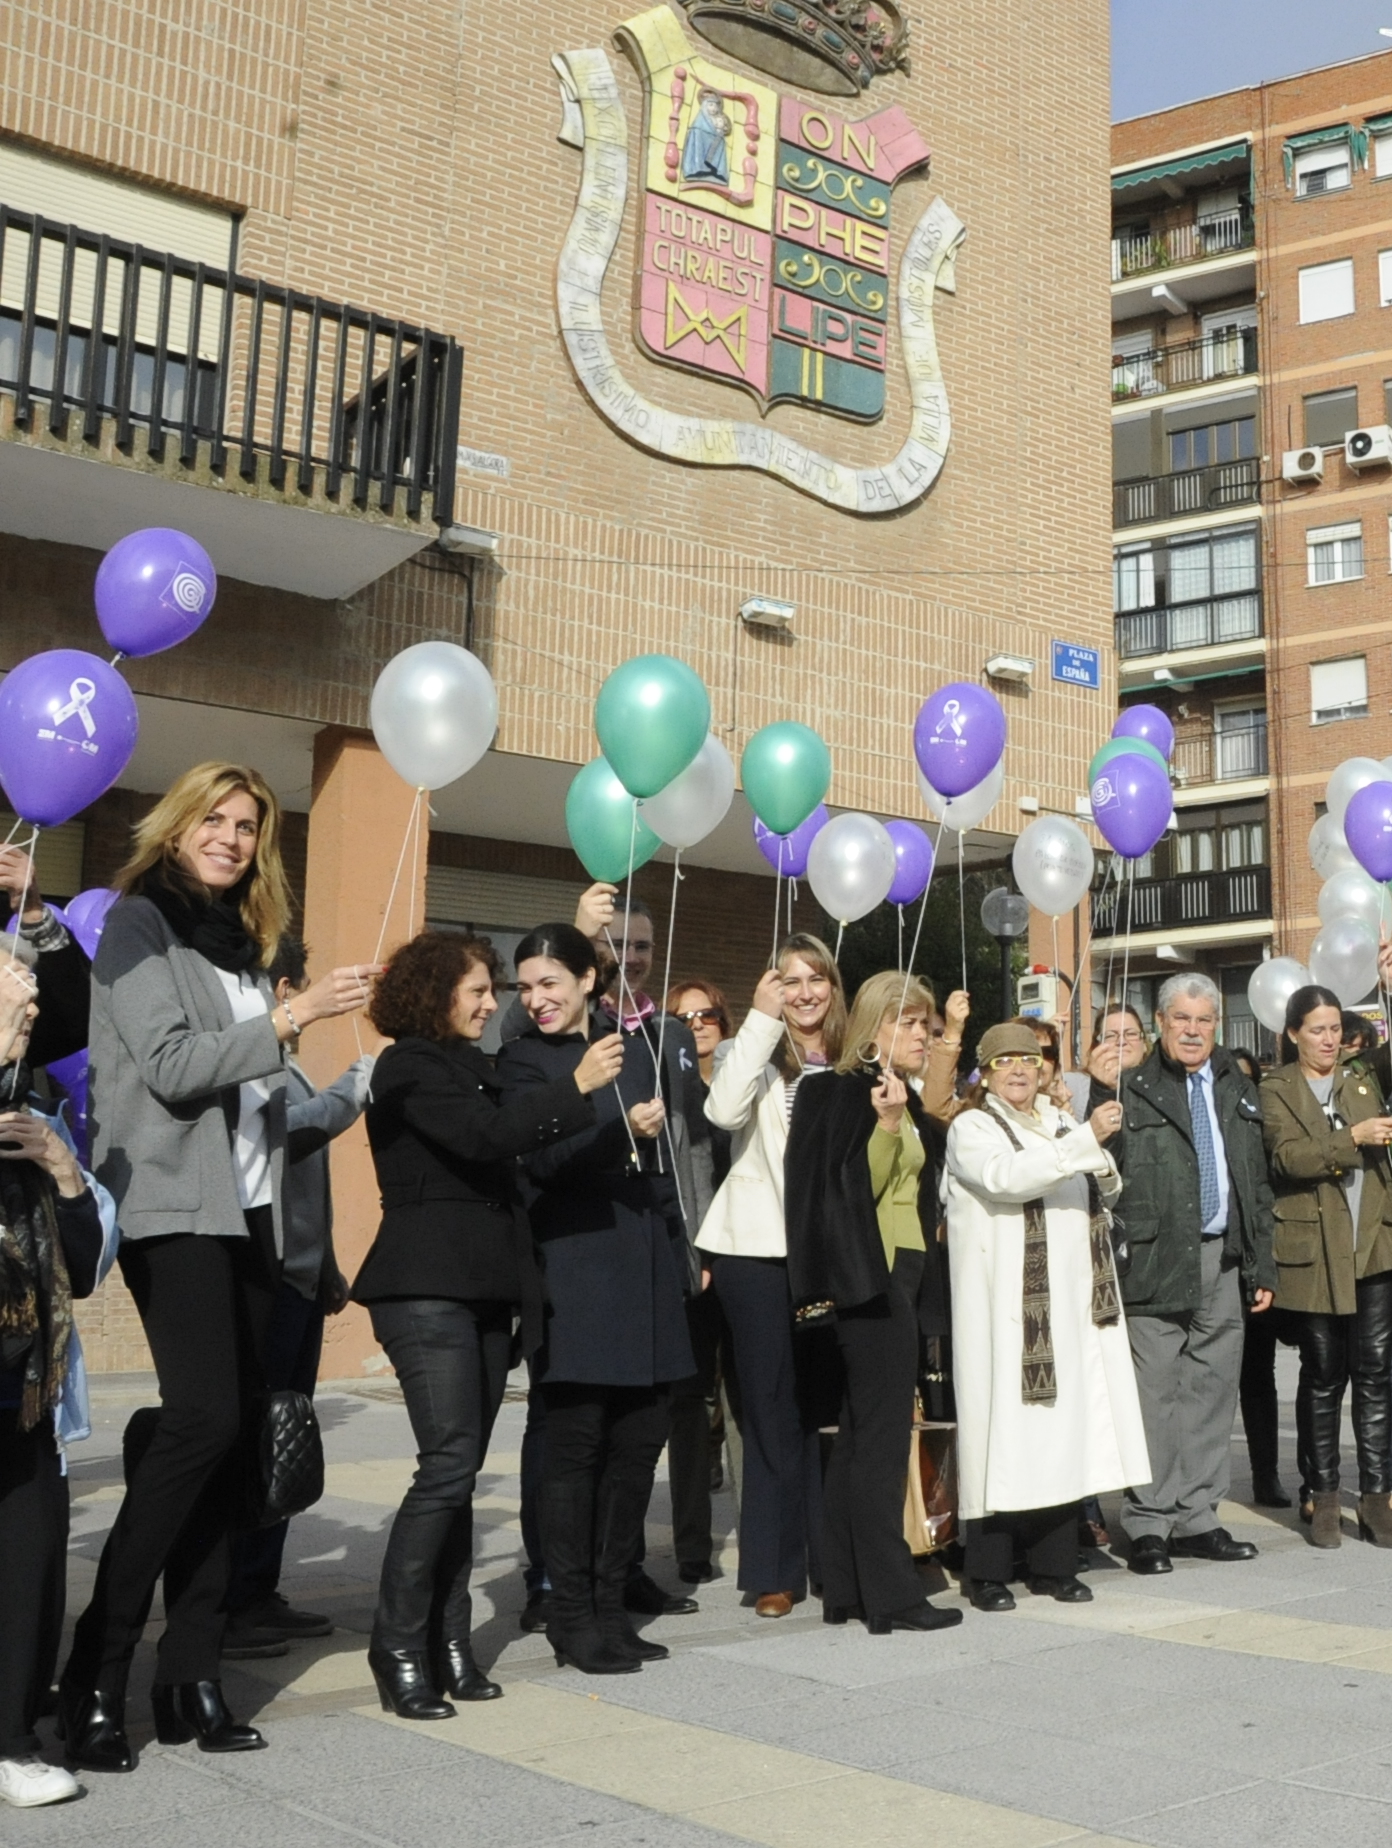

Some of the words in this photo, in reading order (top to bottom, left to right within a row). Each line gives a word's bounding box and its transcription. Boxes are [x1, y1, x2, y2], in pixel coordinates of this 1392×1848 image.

[801, 111, 876, 171] ON
[781, 195, 885, 268] PHE
[778, 294, 883, 363] LIPE
[862, 478, 892, 500] DE
[897, 457, 928, 486] LA
[1062, 665, 1090, 682] ESPAÑA
[1069, 648, 1094, 662] PLAZA
